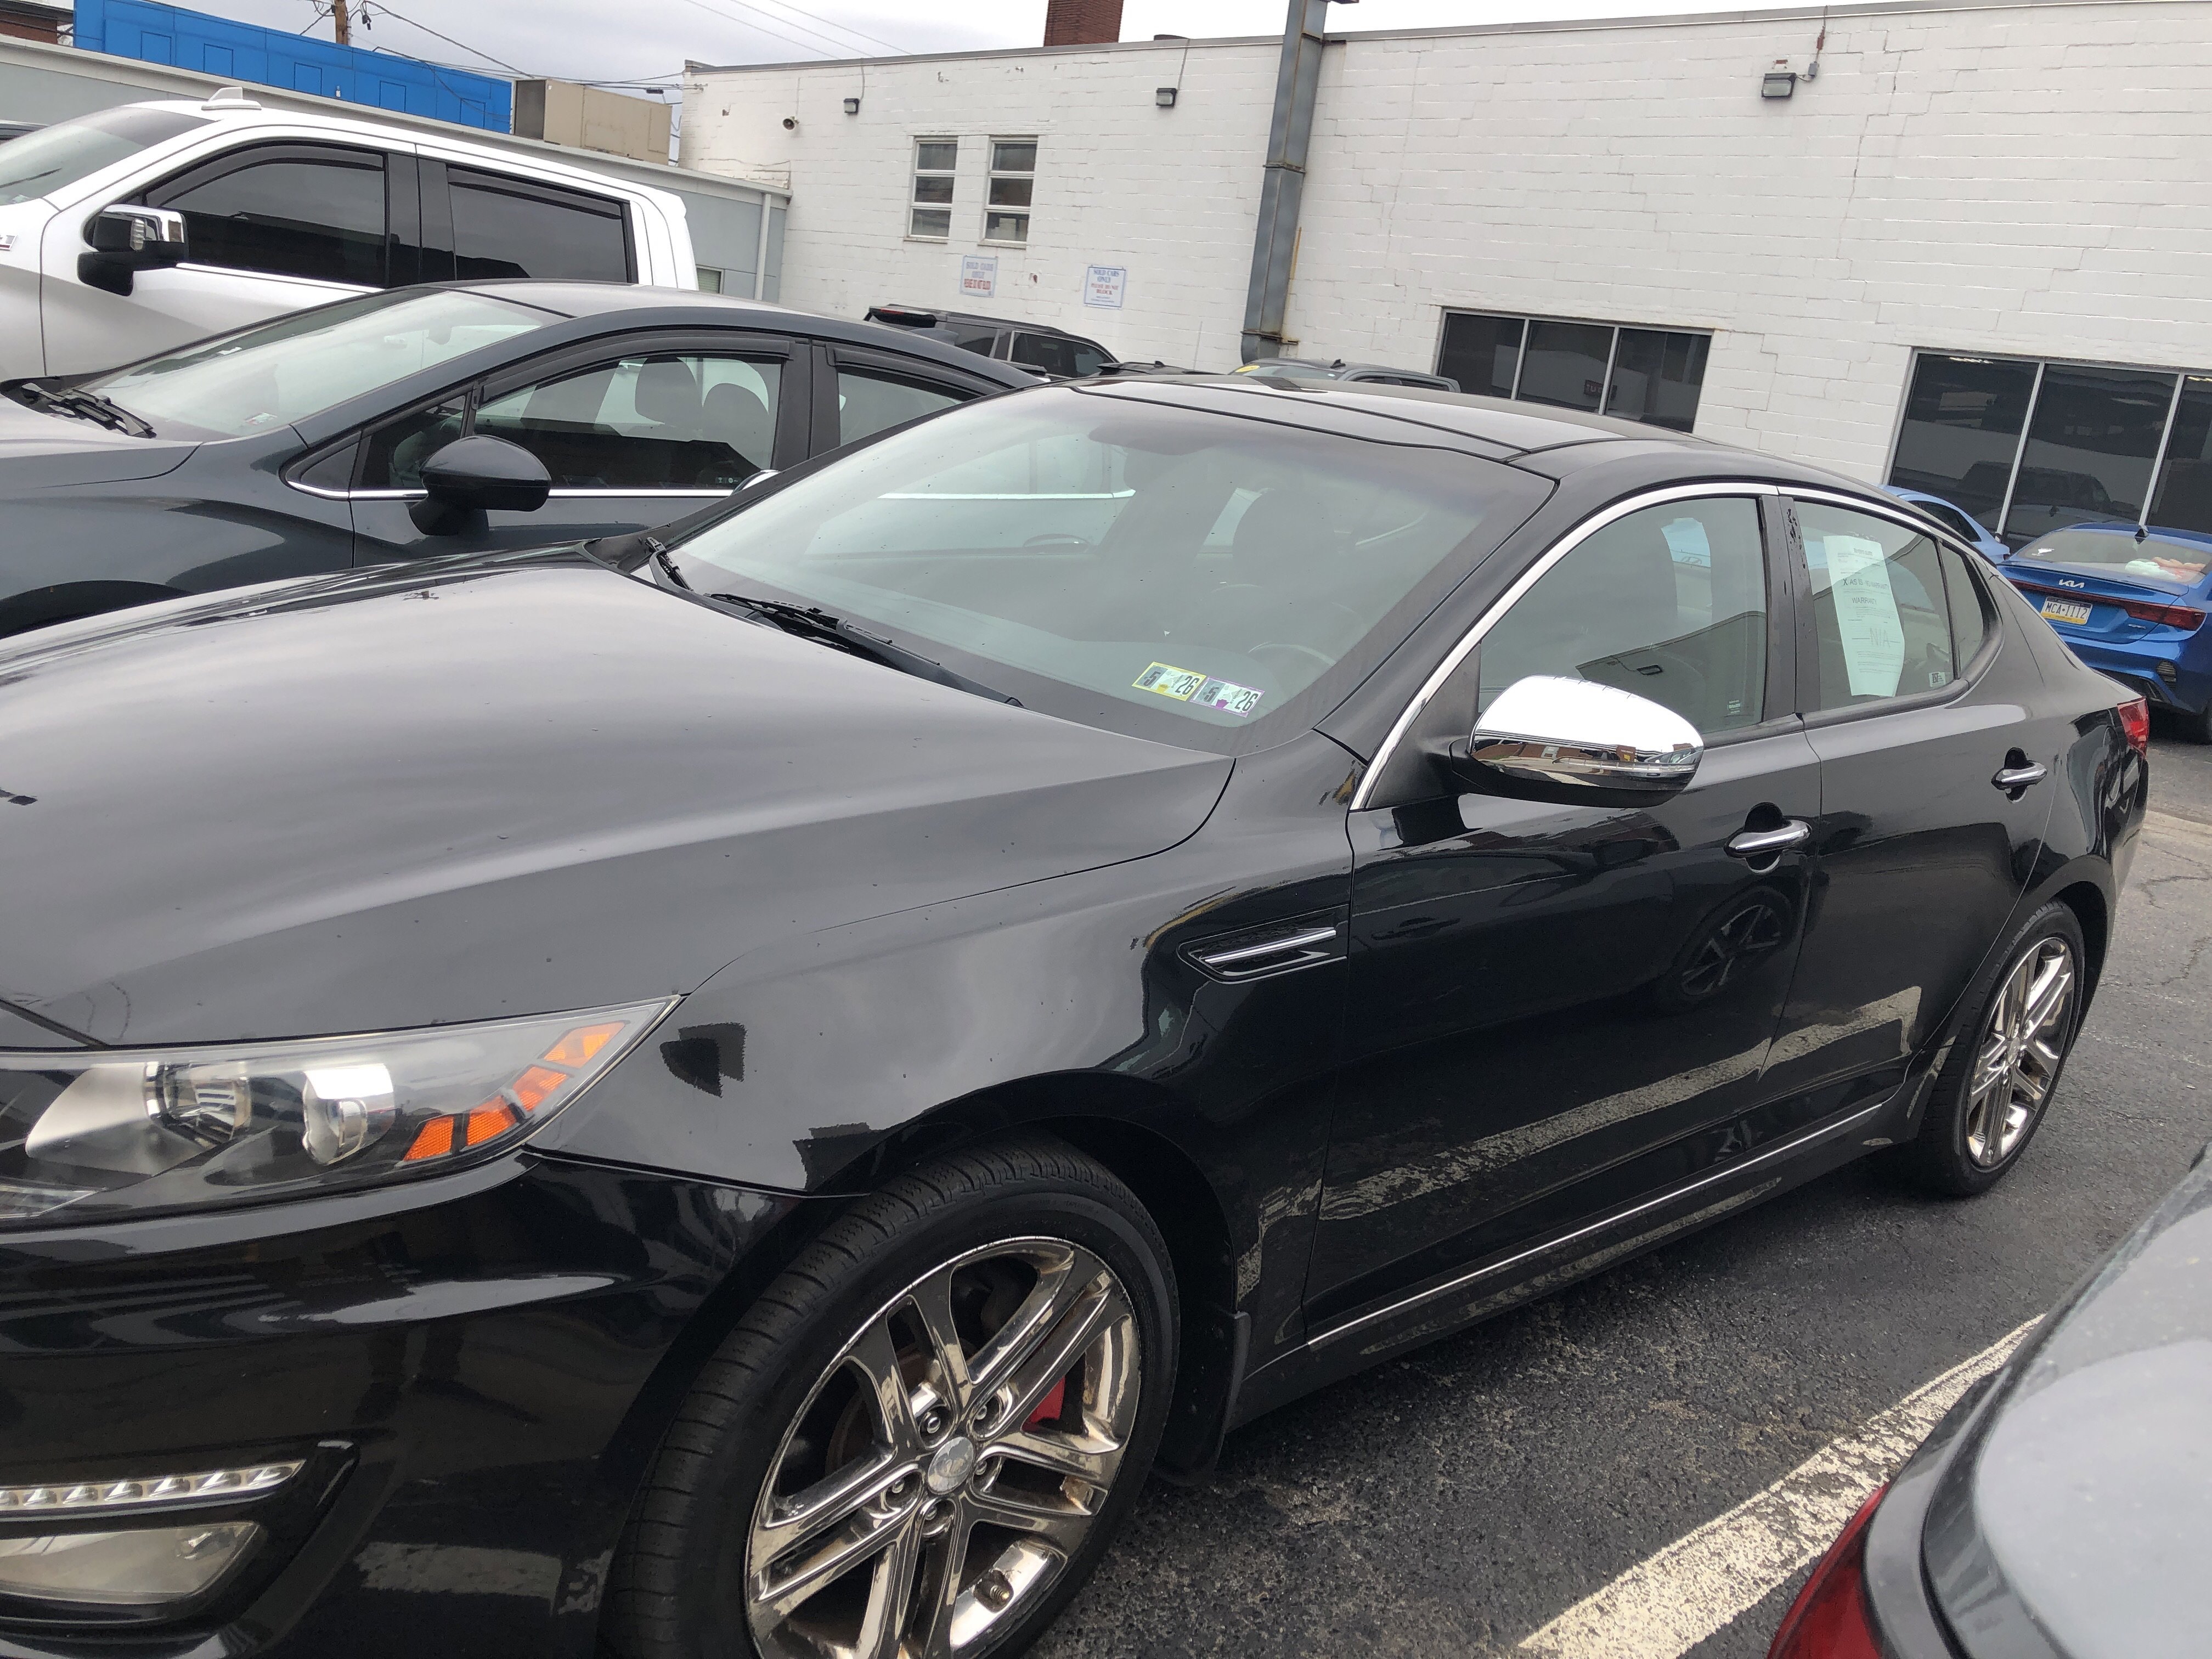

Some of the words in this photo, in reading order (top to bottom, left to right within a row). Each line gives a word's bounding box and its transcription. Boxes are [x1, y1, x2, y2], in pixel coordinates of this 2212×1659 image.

[2058, 579, 2085, 588] KIA
[1175, 675, 1200, 695] 26
[1234, 691, 1259, 712] 26
